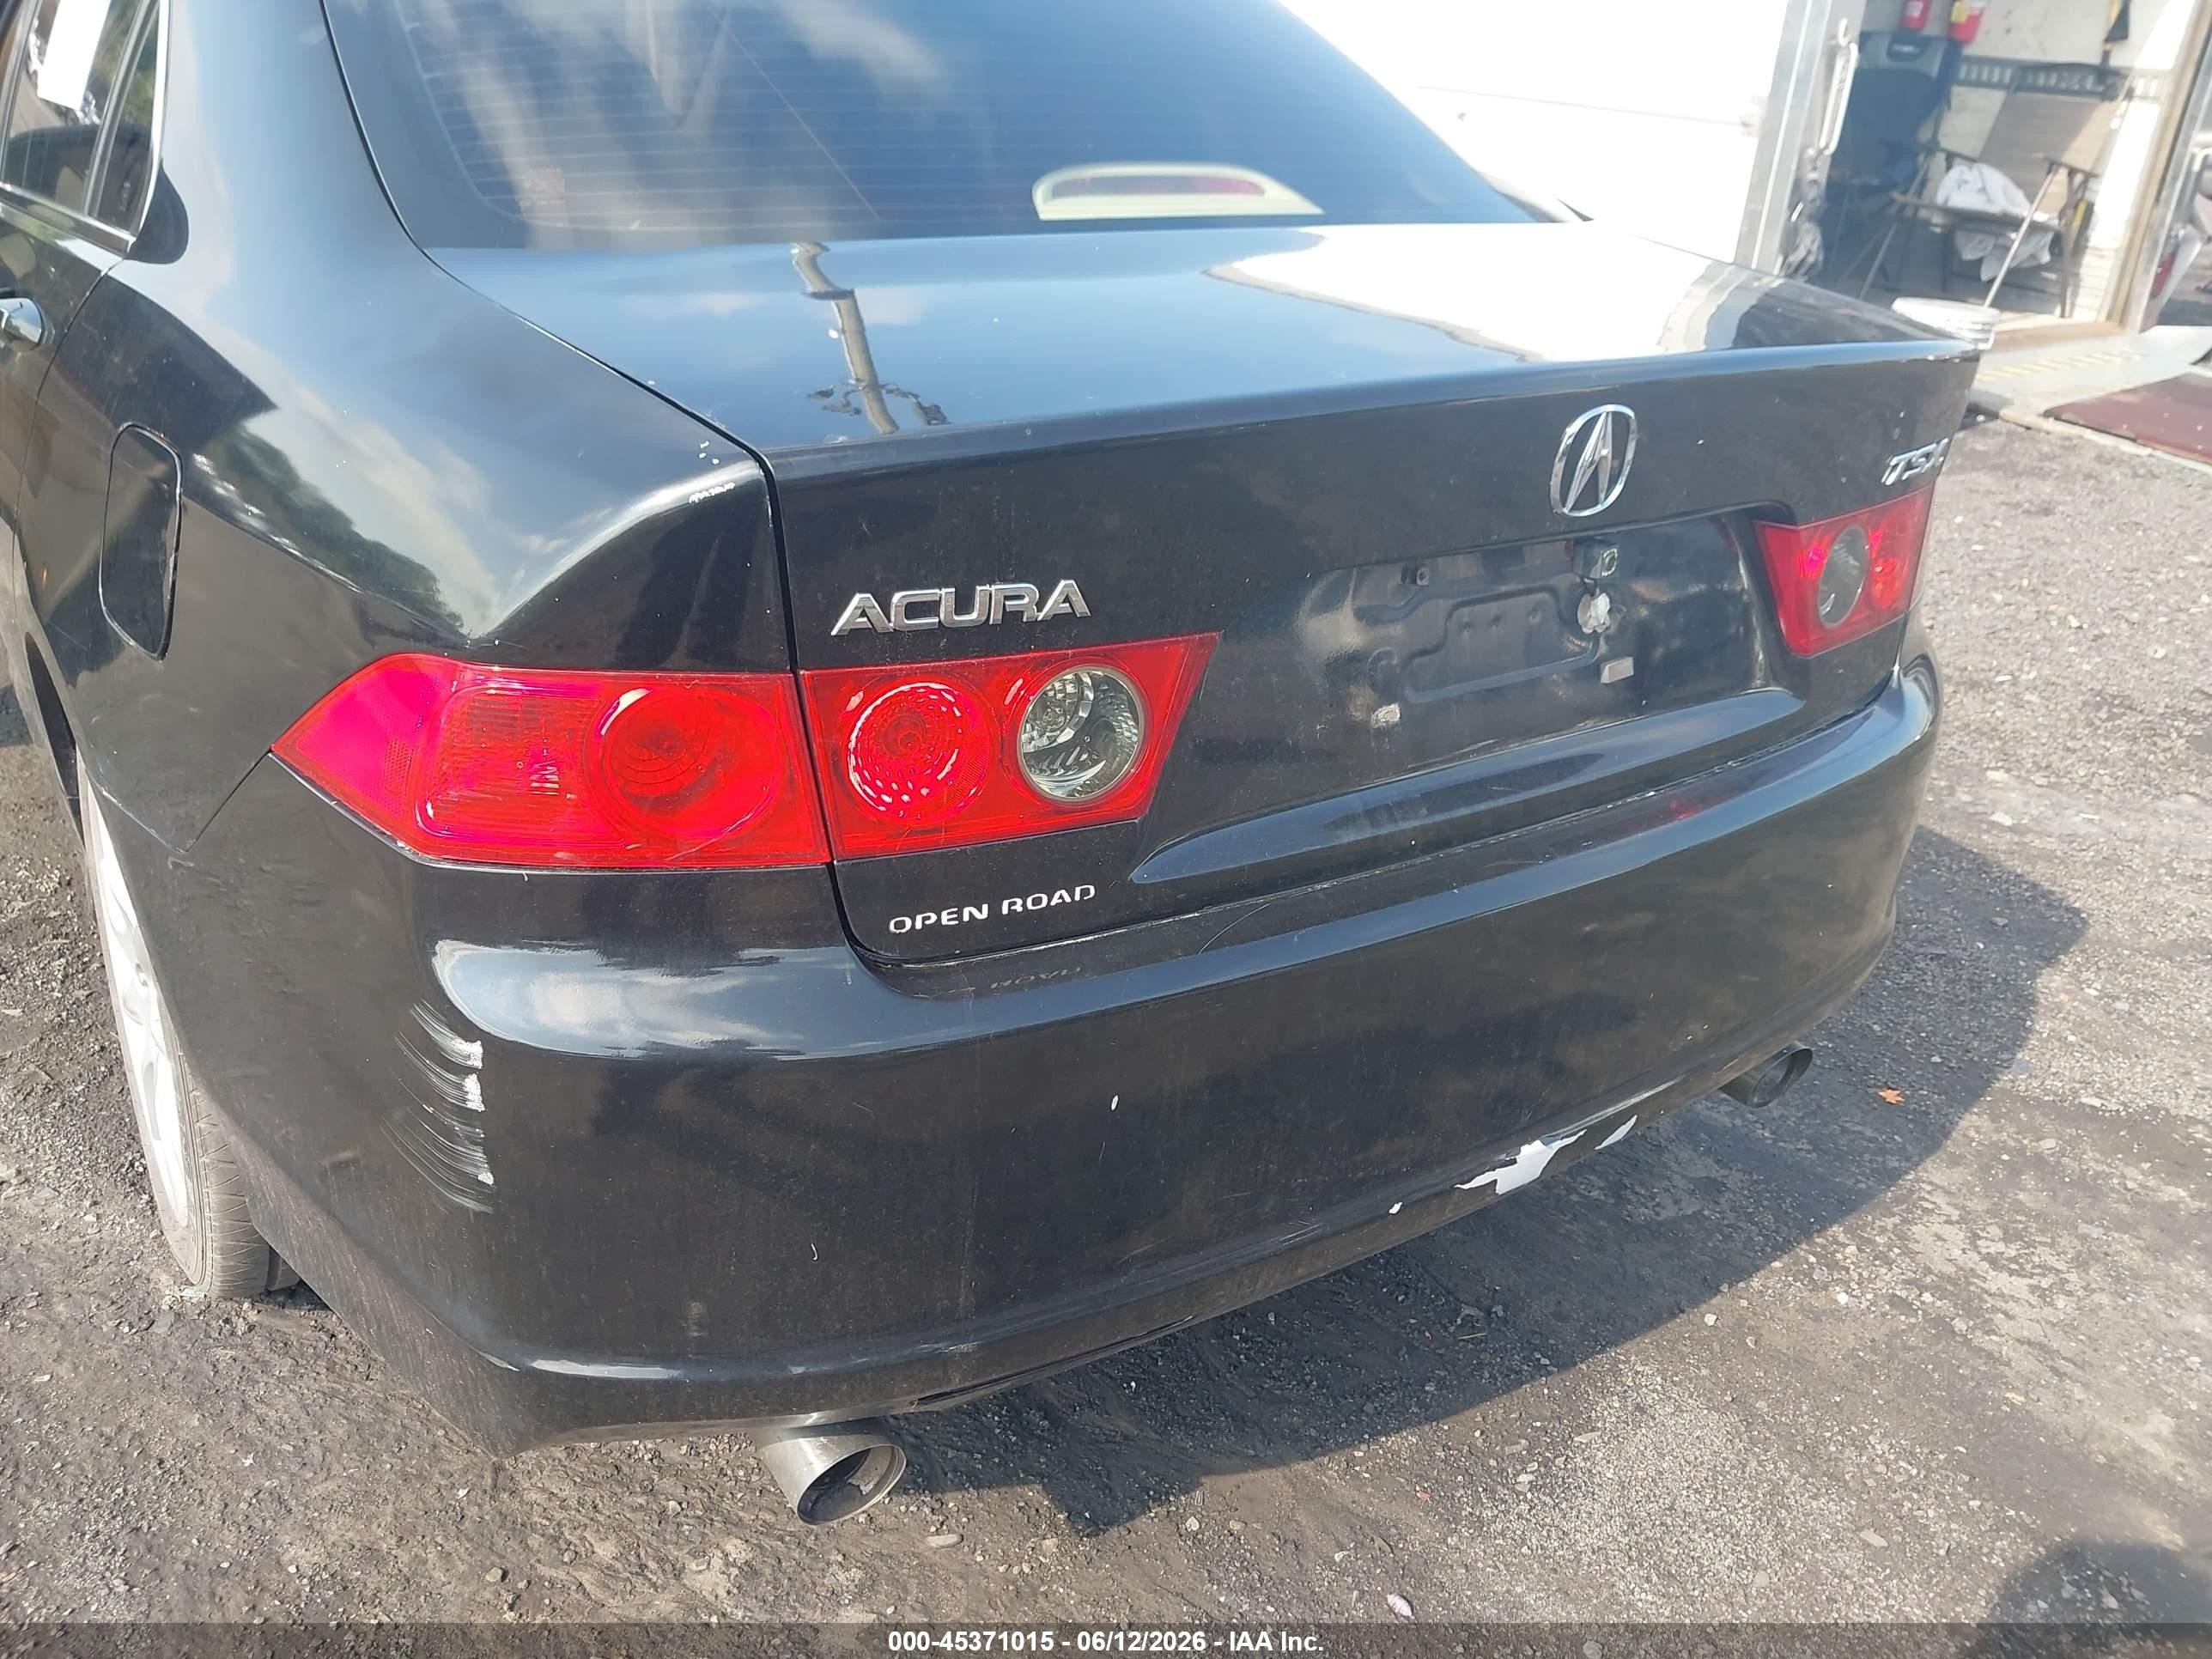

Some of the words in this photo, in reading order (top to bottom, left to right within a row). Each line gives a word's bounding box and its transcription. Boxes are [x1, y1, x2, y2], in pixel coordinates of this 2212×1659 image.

[830, 579, 1091, 635] ACURA
[889, 903, 988, 933] OPEN
[1001, 884, 1096, 915] ROAD
